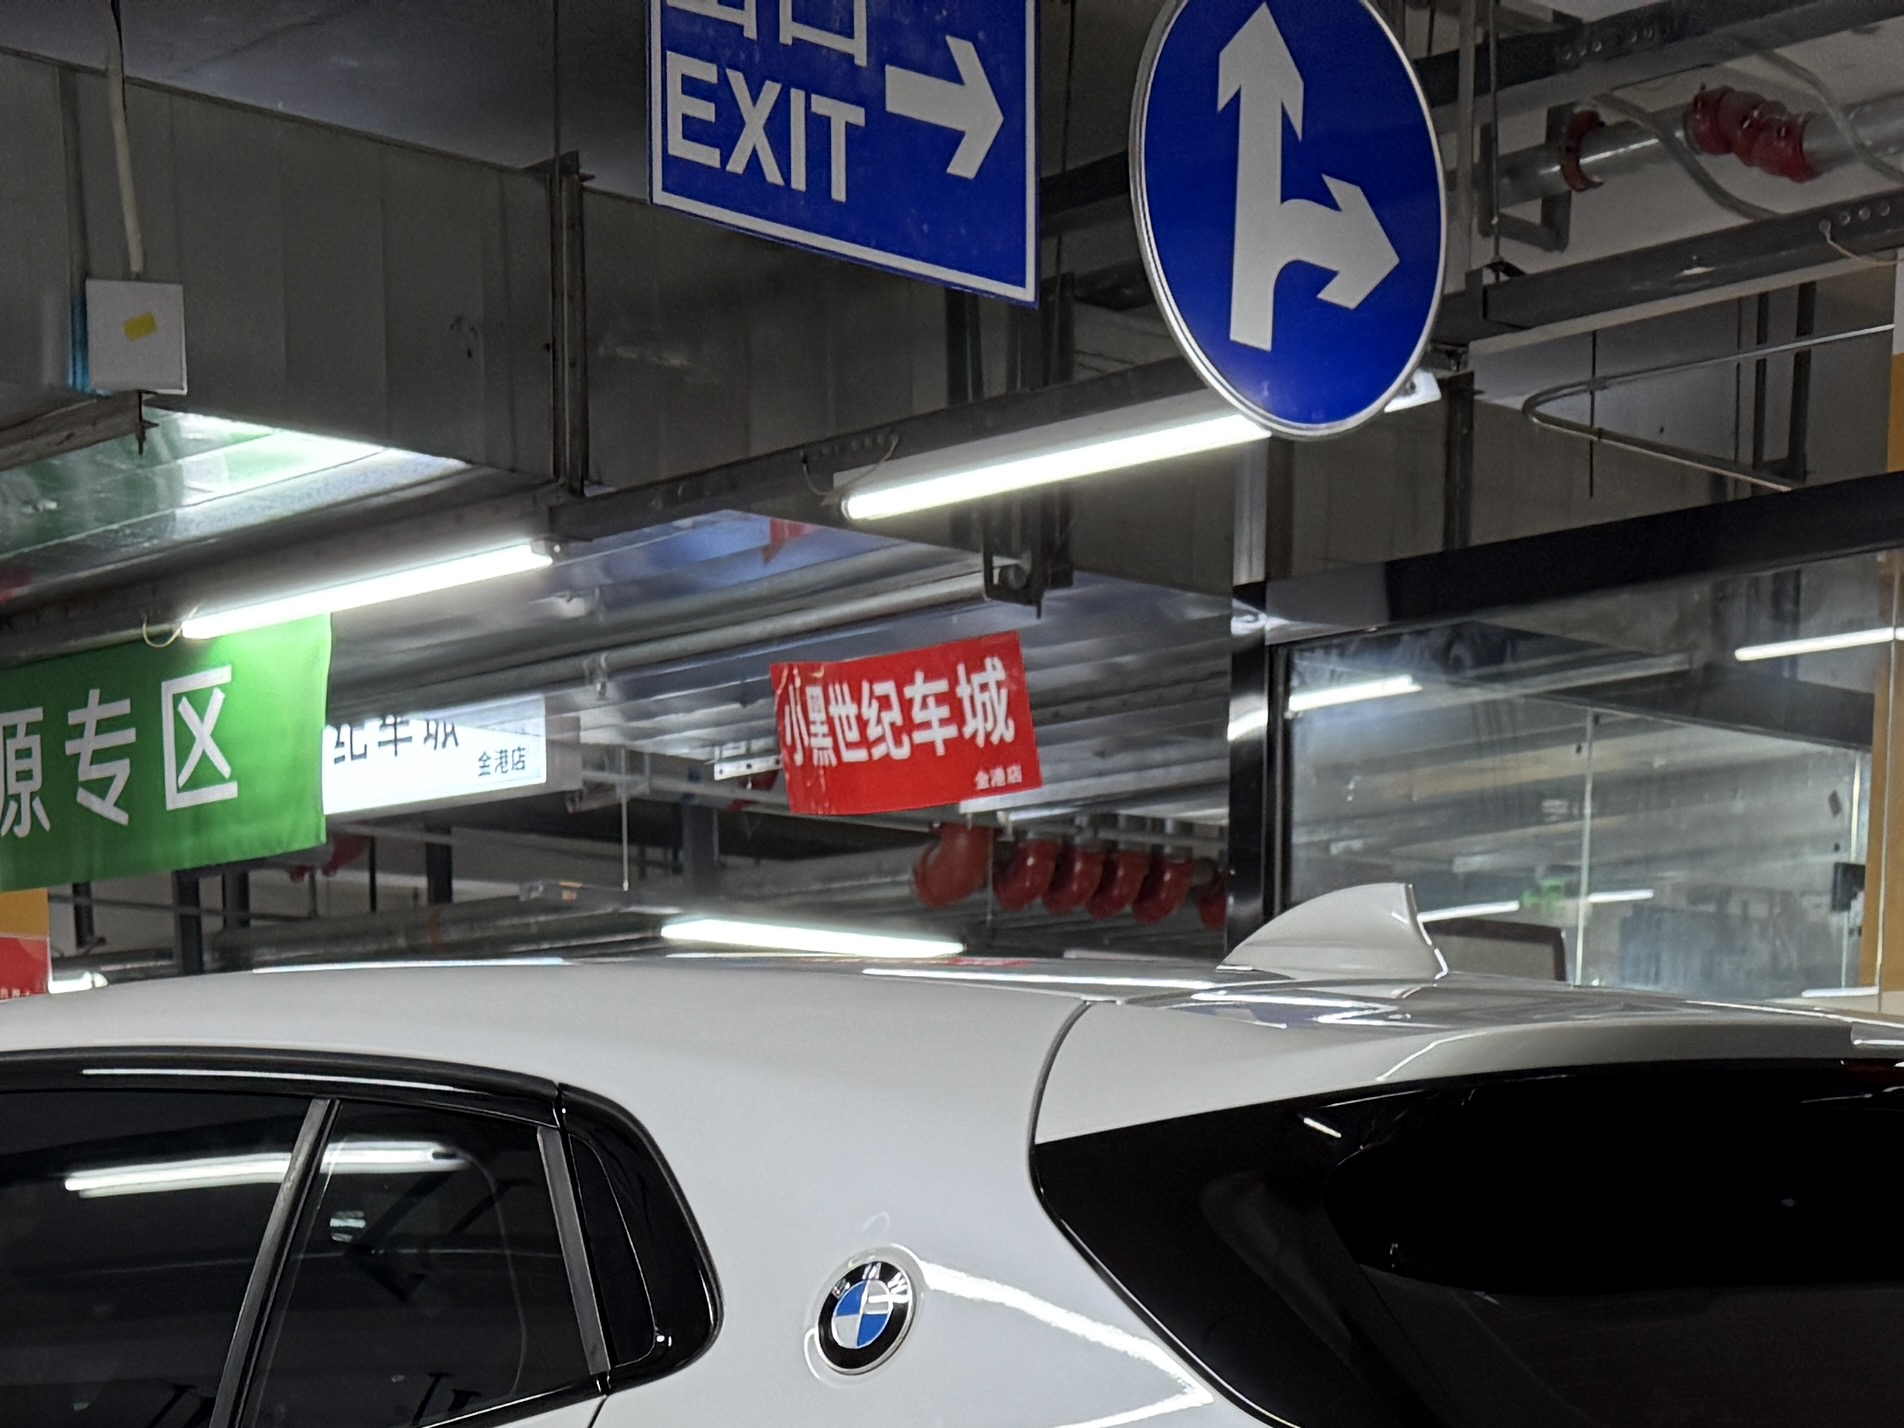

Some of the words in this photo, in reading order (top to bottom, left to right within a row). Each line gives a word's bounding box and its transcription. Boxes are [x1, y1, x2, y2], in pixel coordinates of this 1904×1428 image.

[667, 50, 865, 203] EXIT
[784, 656, 1015, 767] 小黑世纪车城
[477, 745, 526, 777] 金港店
[974, 764, 1023, 790] 金港店
